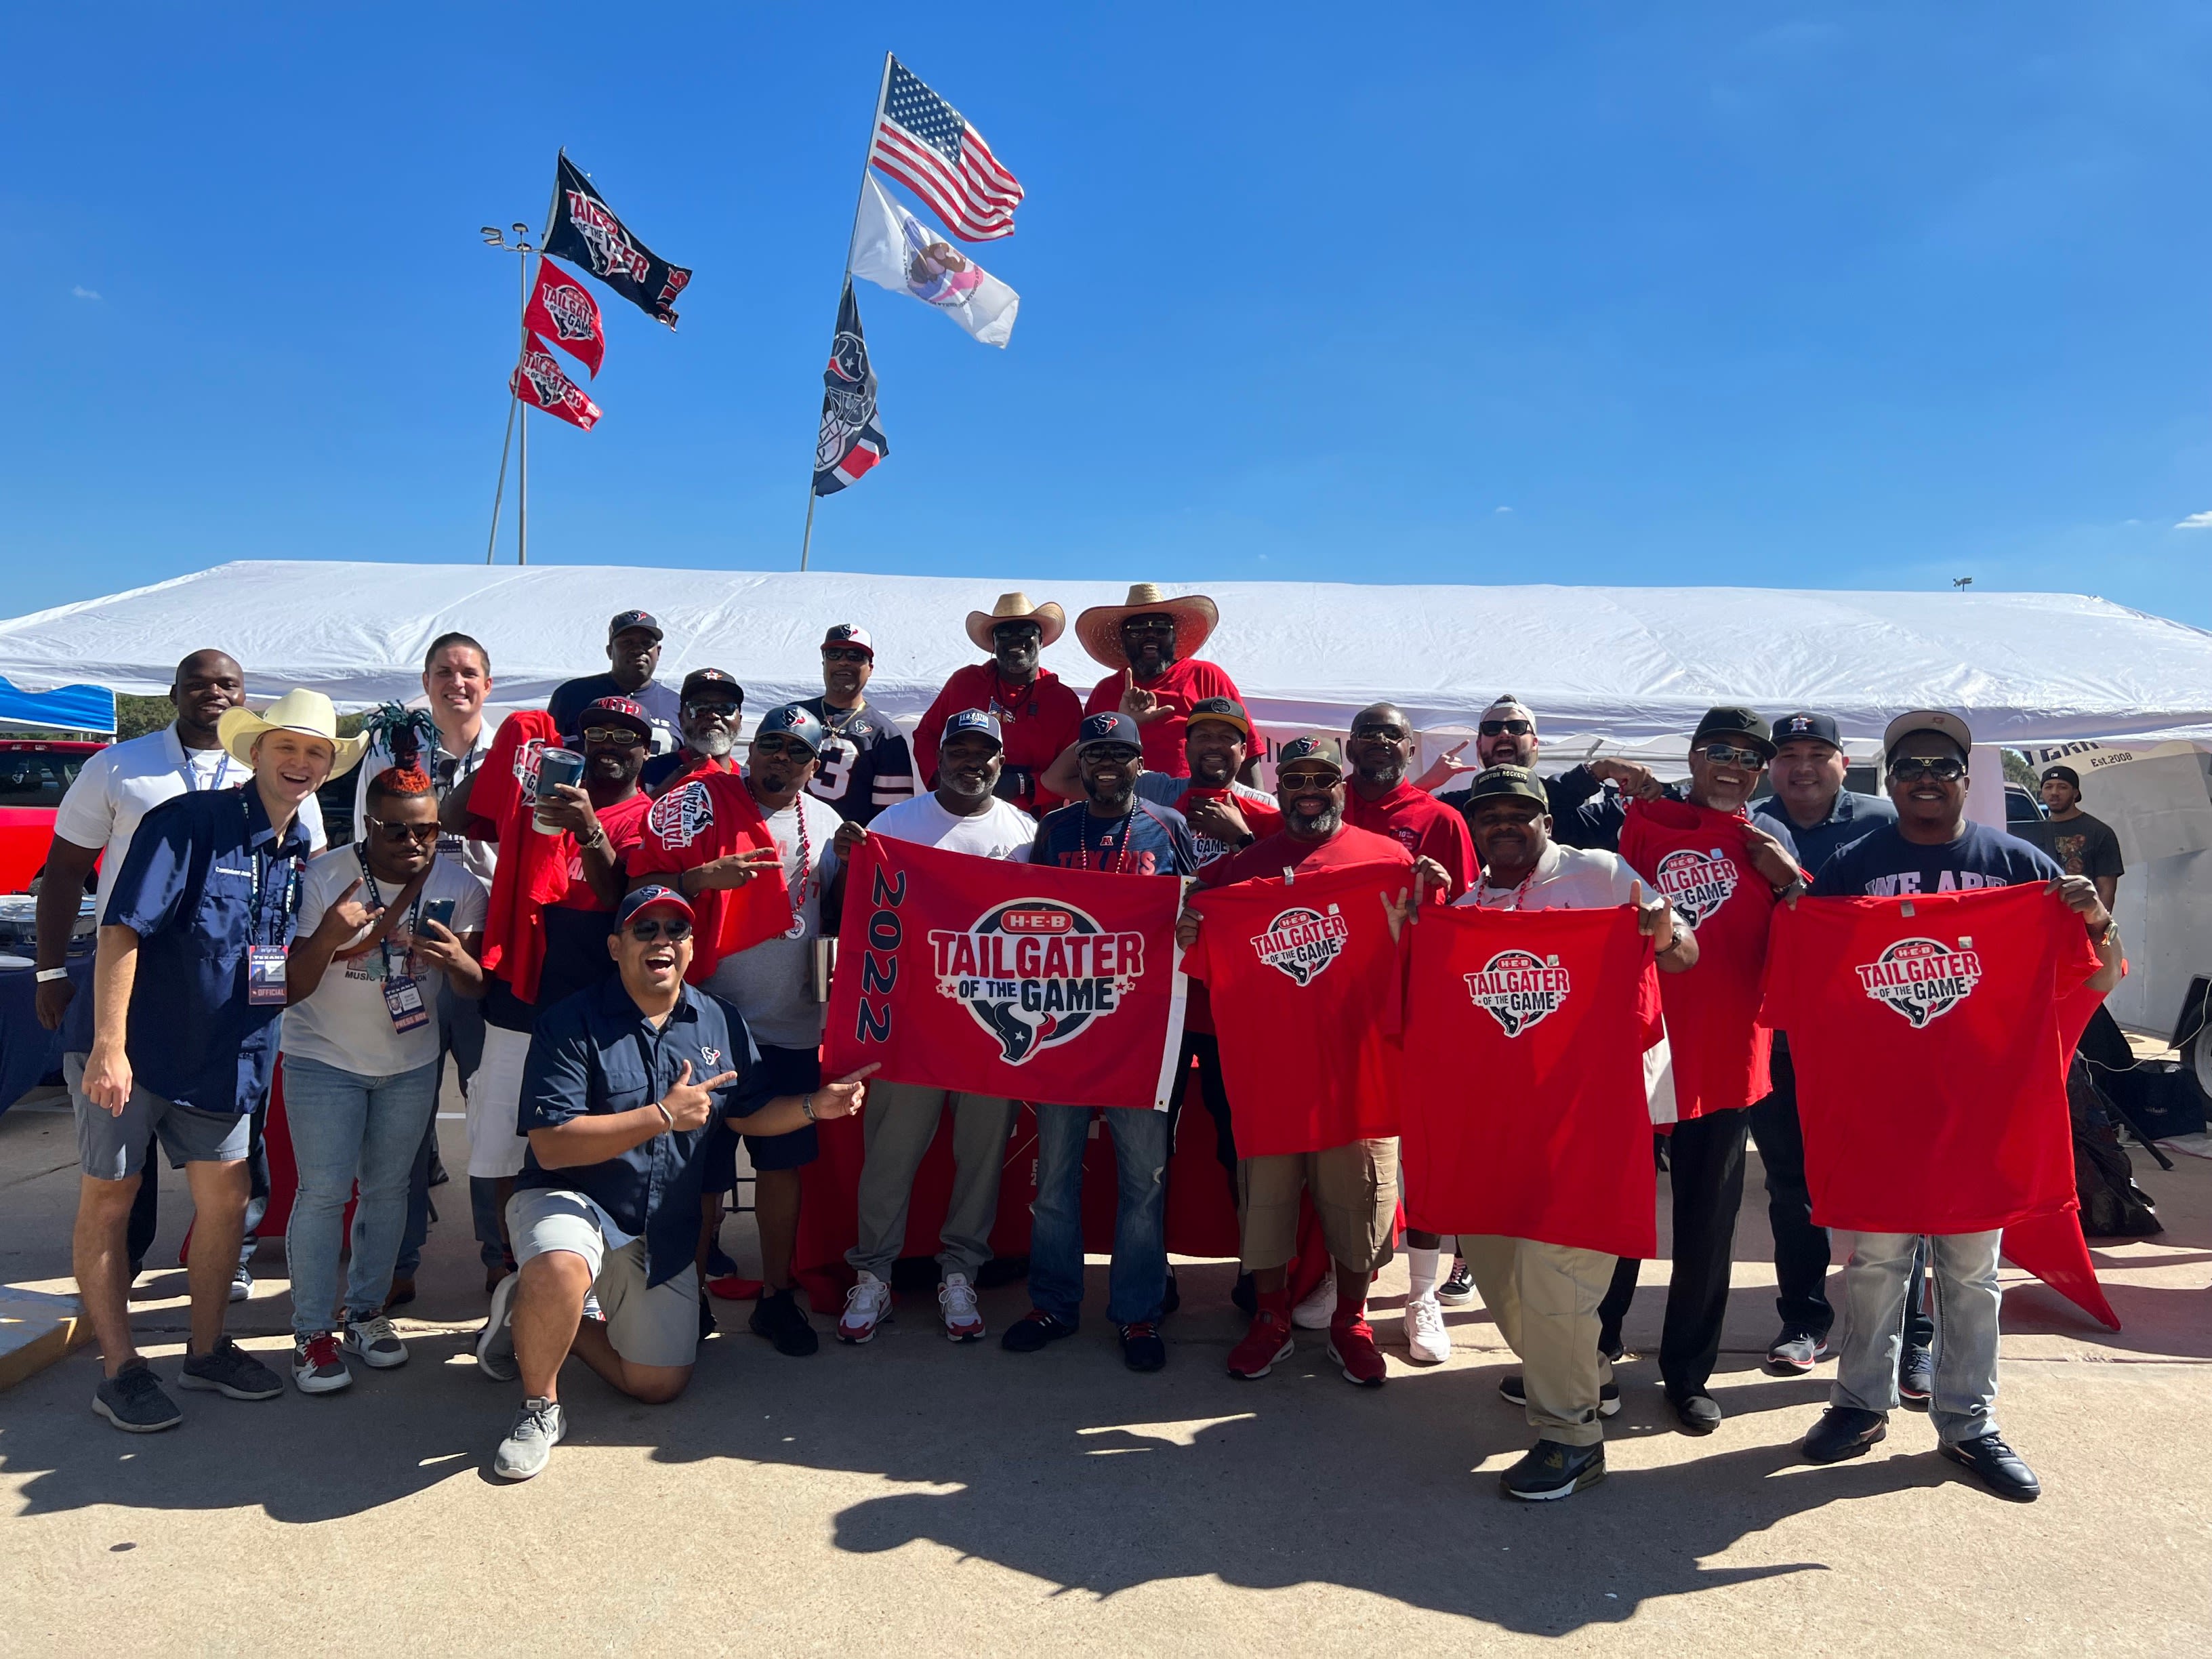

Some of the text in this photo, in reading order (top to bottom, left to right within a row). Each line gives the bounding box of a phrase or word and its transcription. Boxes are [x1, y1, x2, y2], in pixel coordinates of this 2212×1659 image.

[591, 227, 602, 240] THE
[544, 285, 594, 324] TAILGATE
[559, 309, 567, 319] THE
[1502, 771, 1528, 781] ROCKETS
[682, 783, 703, 813] GAME
[663, 786, 687, 849] TAILGATE
[684, 827, 691, 836] OF
[1197, 839, 1227, 853] GAME
[1059, 851, 1155, 875] TEXANS
[363, 865, 377, 897] TEXANS
[1654, 860, 1736, 895] AILGATER
[1866, 872, 1921, 896] WE
[1684, 880, 1729, 905] GAME
[1010, 915, 1067, 928] H-E-B
[1282, 915, 1307, 926] H-E-B
[1252, 917, 1347, 956] TAILGATER
[855, 862, 906, 1044] 2022
[930, 931, 1143, 978] TAILGATER
[1270, 937, 1339, 963] OF THE GAME
[1898, 946, 1931, 957] H-E-B
[1465, 969, 1569, 996] TAILGATER
[1858, 953, 1980, 988] TAILGATER
[958, 977, 1114, 1012] OF THE GAME
[1483, 991, 1555, 1010] OF THE GAME
[1879, 977, 1968, 1000] OF THE GAME
